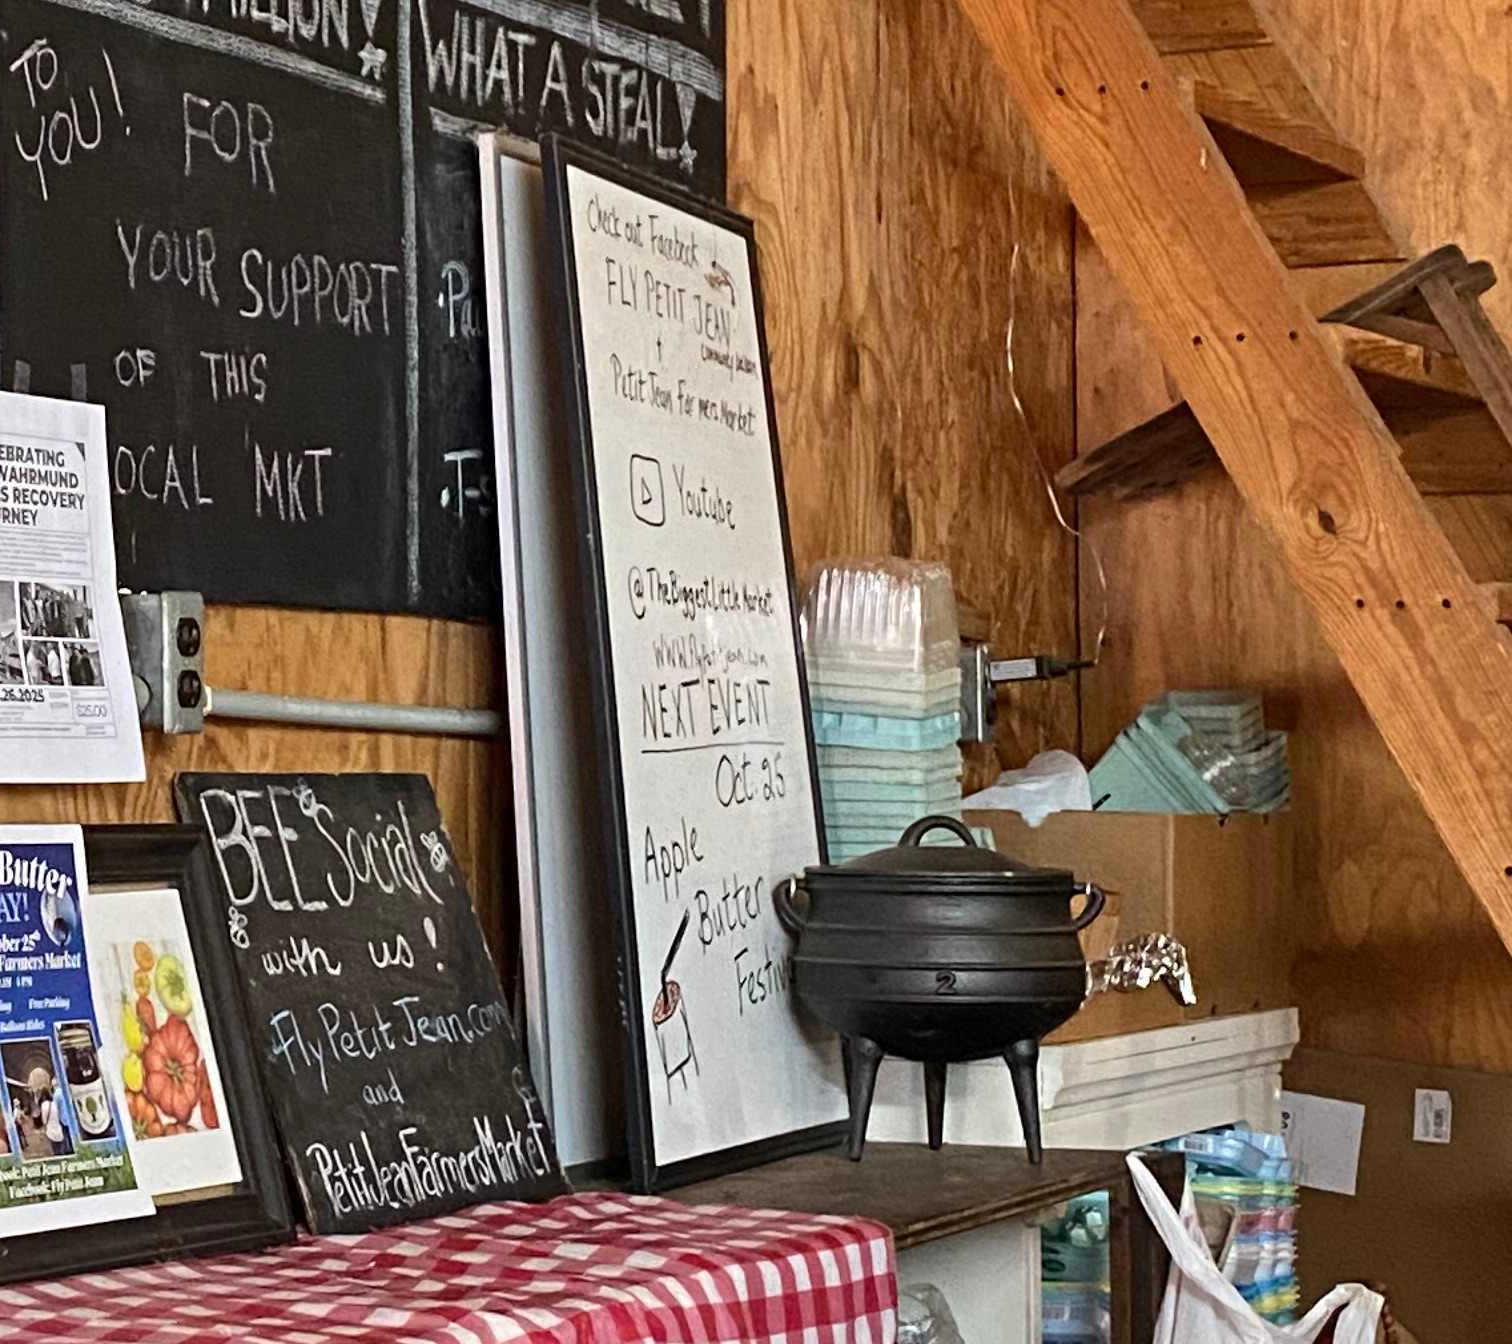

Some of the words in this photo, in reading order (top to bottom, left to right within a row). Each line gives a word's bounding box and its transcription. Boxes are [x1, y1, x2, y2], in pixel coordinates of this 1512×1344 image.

[8, 38, 60, 108] TO
[540, 40, 575, 127] A
[182, 91, 276, 196] FOR
[115, 216, 221, 308] YOUR
[239, 247, 399, 337] SUPPORT
[605, 255, 639, 311] FLY
[645, 268, 686, 325] PETIT
[692, 294, 732, 347] JEAN
[113, 348, 157, 388] OF
[199, 350, 268, 404] THIS
[609, 351, 647, 404] Petit
[647, 371, 674, 416] Jean
[12, 487, 86, 511] RECOVERY
[113, 443, 214, 511] OCAL
[253, 441, 333, 523] MKT
[641, 678, 700, 742] NEXT
[707, 677, 771, 735] EVENT
[761, 751, 786, 802] 25
[199, 785, 329, 912] BEE
[315, 799, 445, 908] Social
[644, 815, 705, 904] Apple
[693, 872, 764, 956] Butter
[44, 949, 82, 971] Market
[261, 935, 341, 977] with
[934, 970, 958, 995] 2
[361, 1067, 405, 1106] and
